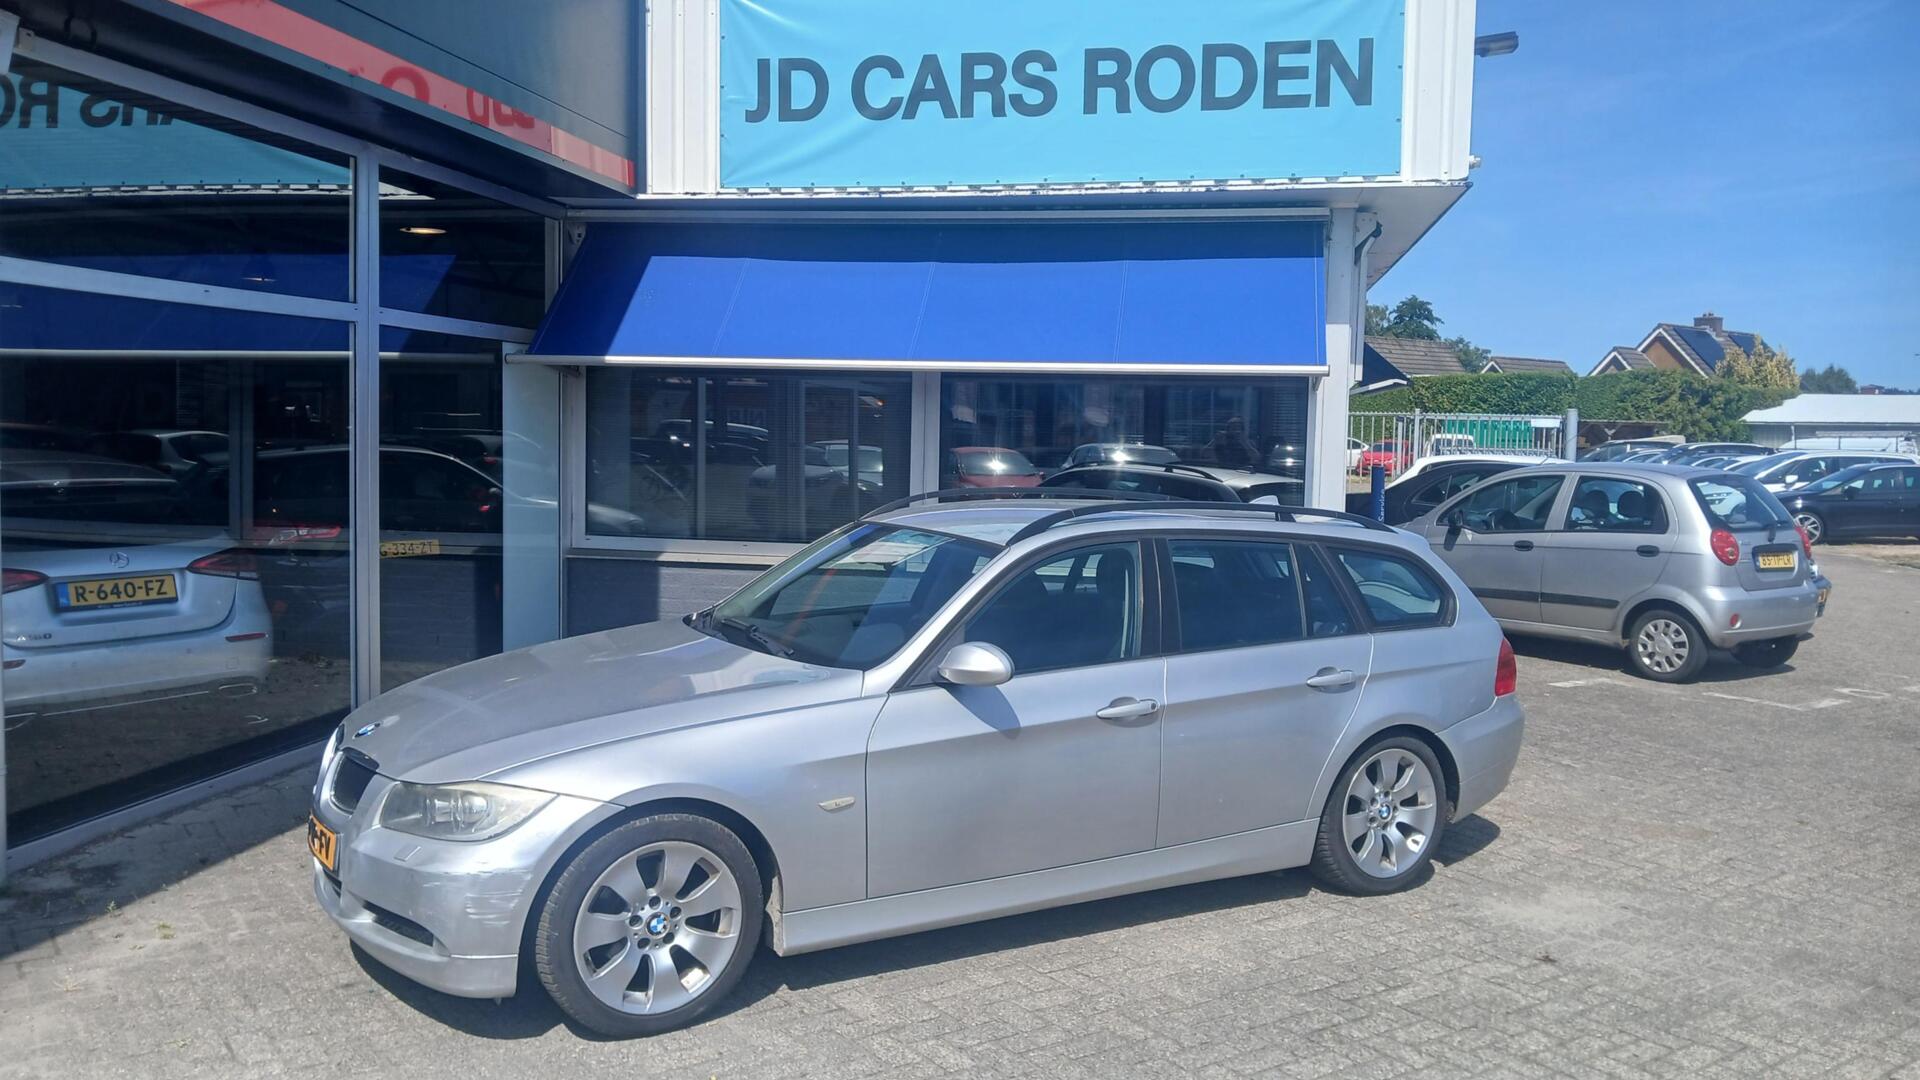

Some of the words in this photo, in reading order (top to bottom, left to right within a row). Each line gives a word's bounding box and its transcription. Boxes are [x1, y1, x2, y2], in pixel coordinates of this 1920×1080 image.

[745, 58, 829, 122] JD
[851, 50, 1057, 120] CARS
[1083, 37, 1374, 115] RODEN
[74, 578, 168, 603] R-640-FZ
